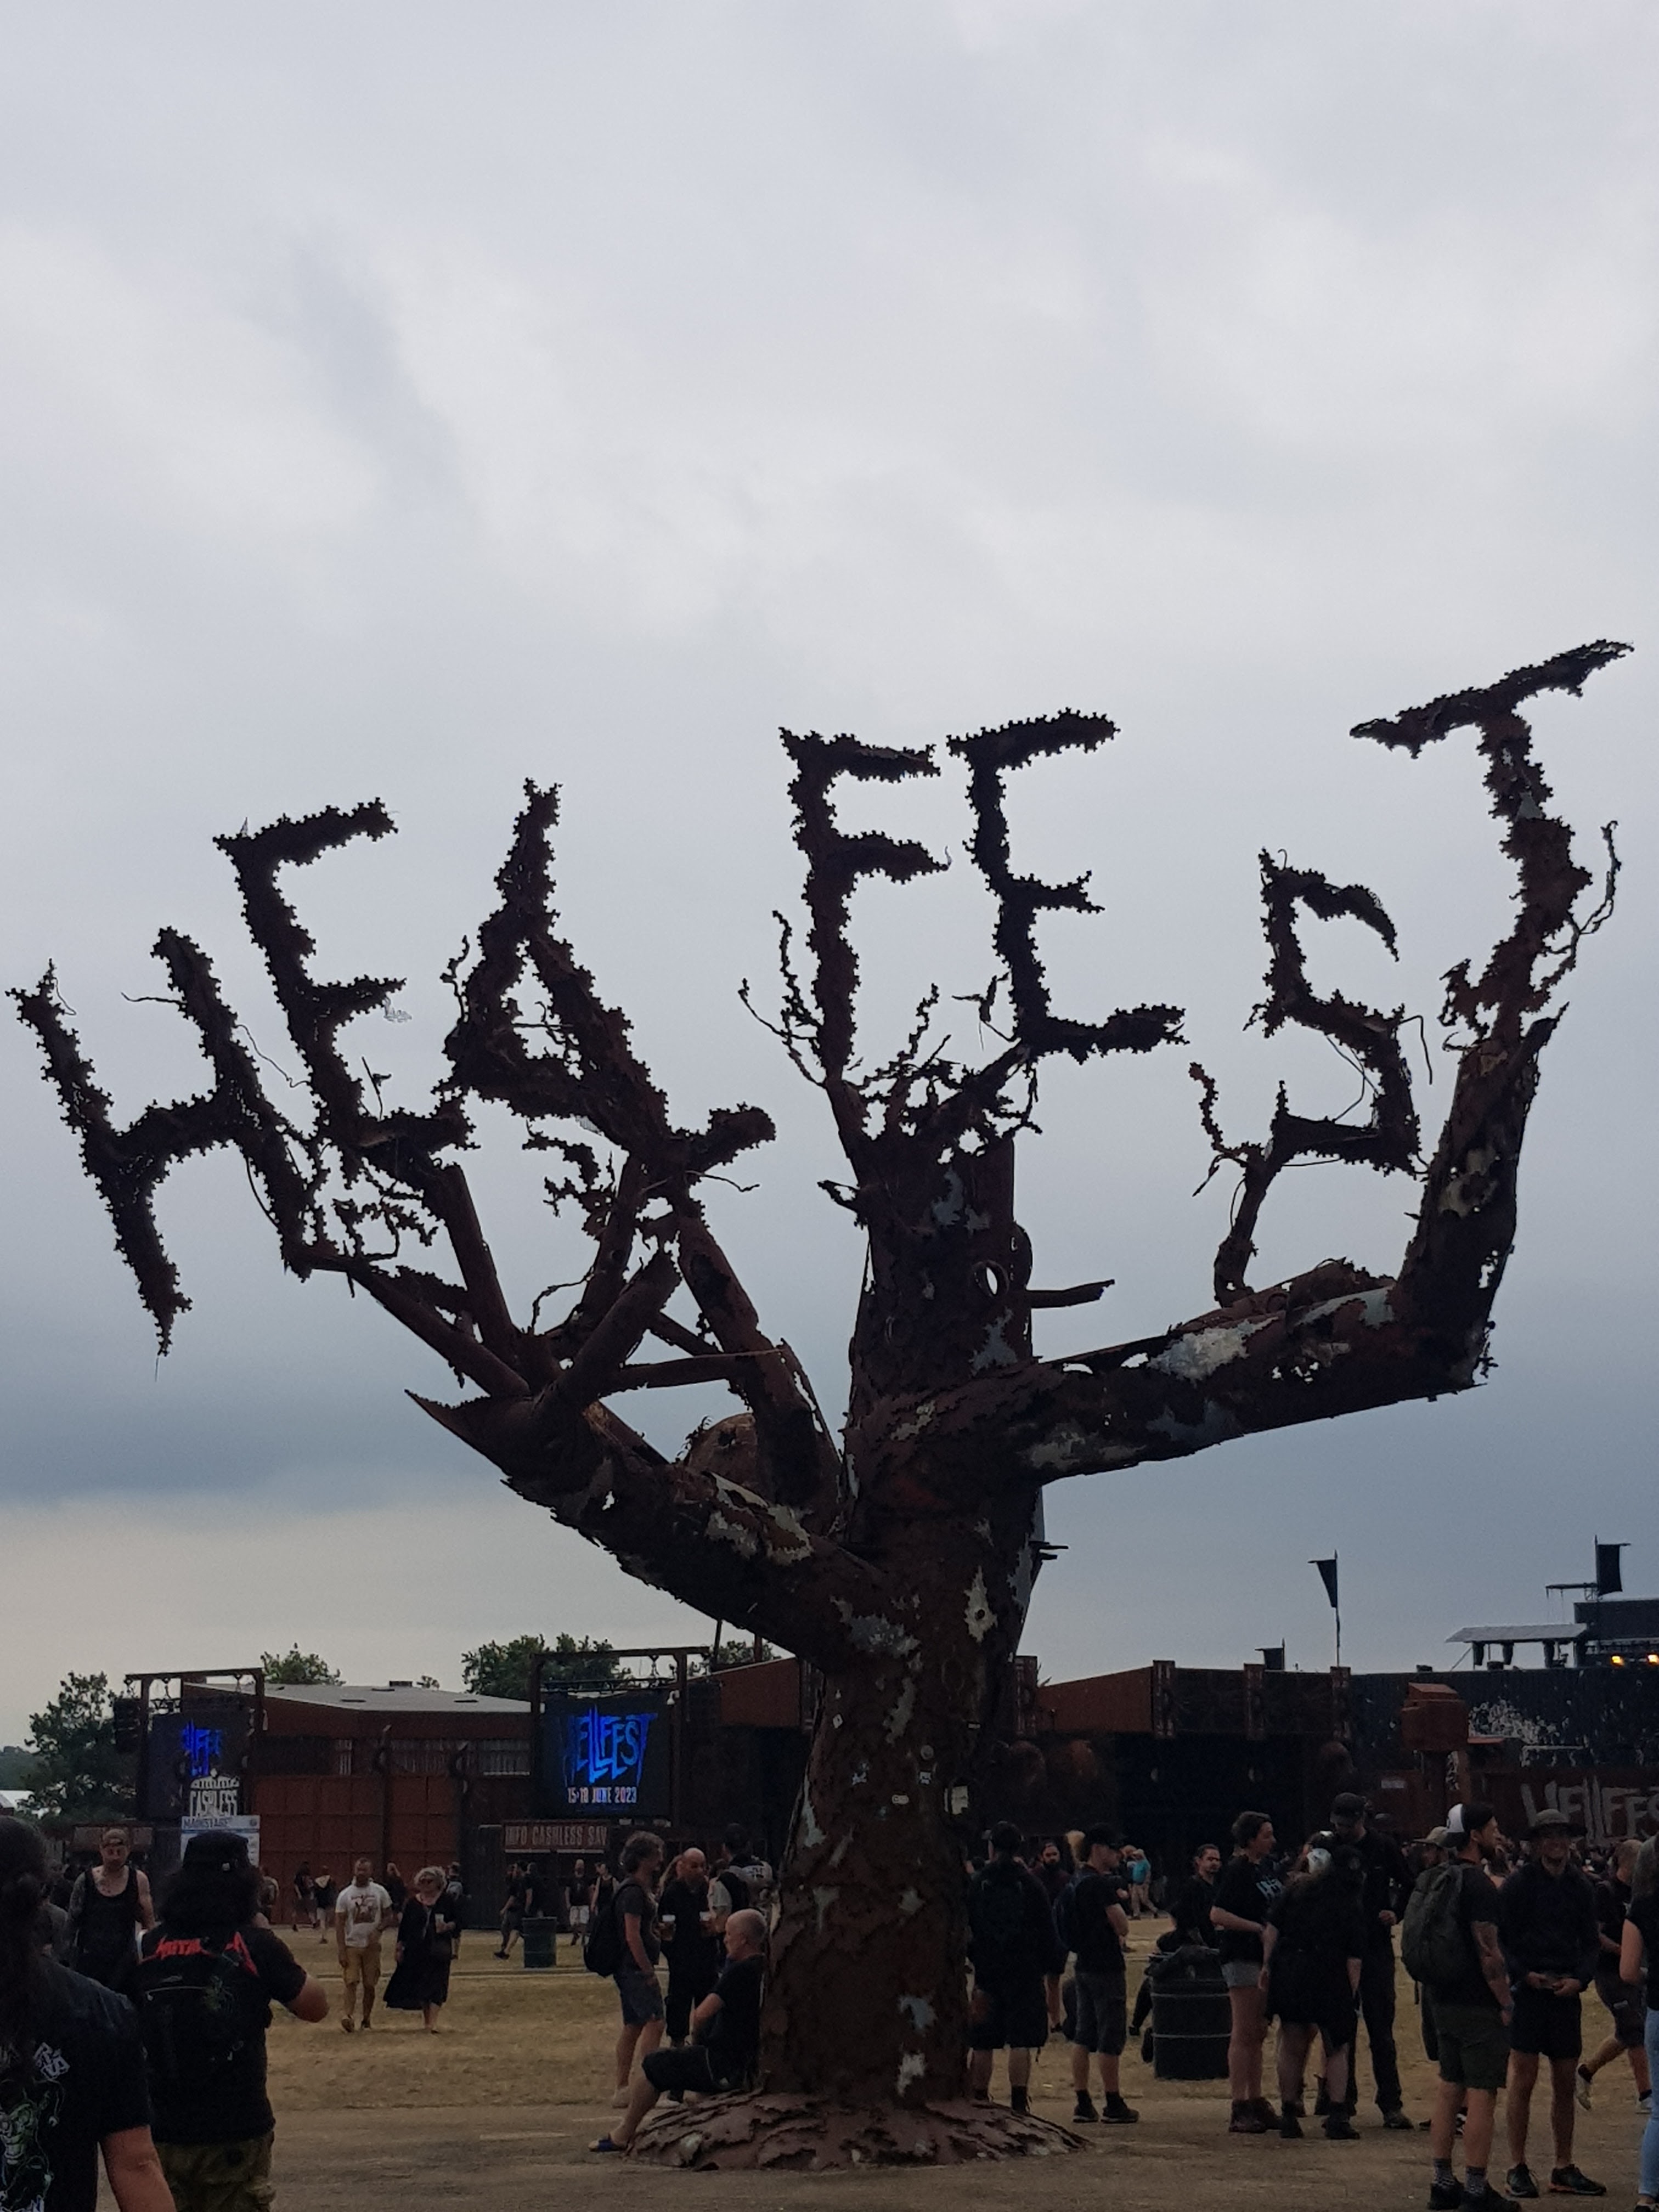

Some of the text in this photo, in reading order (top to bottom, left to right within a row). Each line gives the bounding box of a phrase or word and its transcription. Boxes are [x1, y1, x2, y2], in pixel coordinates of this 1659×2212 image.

[591, 1786, 612, 1803] JUNE
[614, 1786, 637, 1803] 2023
[532, 1825, 583, 1846] CASHLESS
[588, 1826, 607, 1846] SAV
